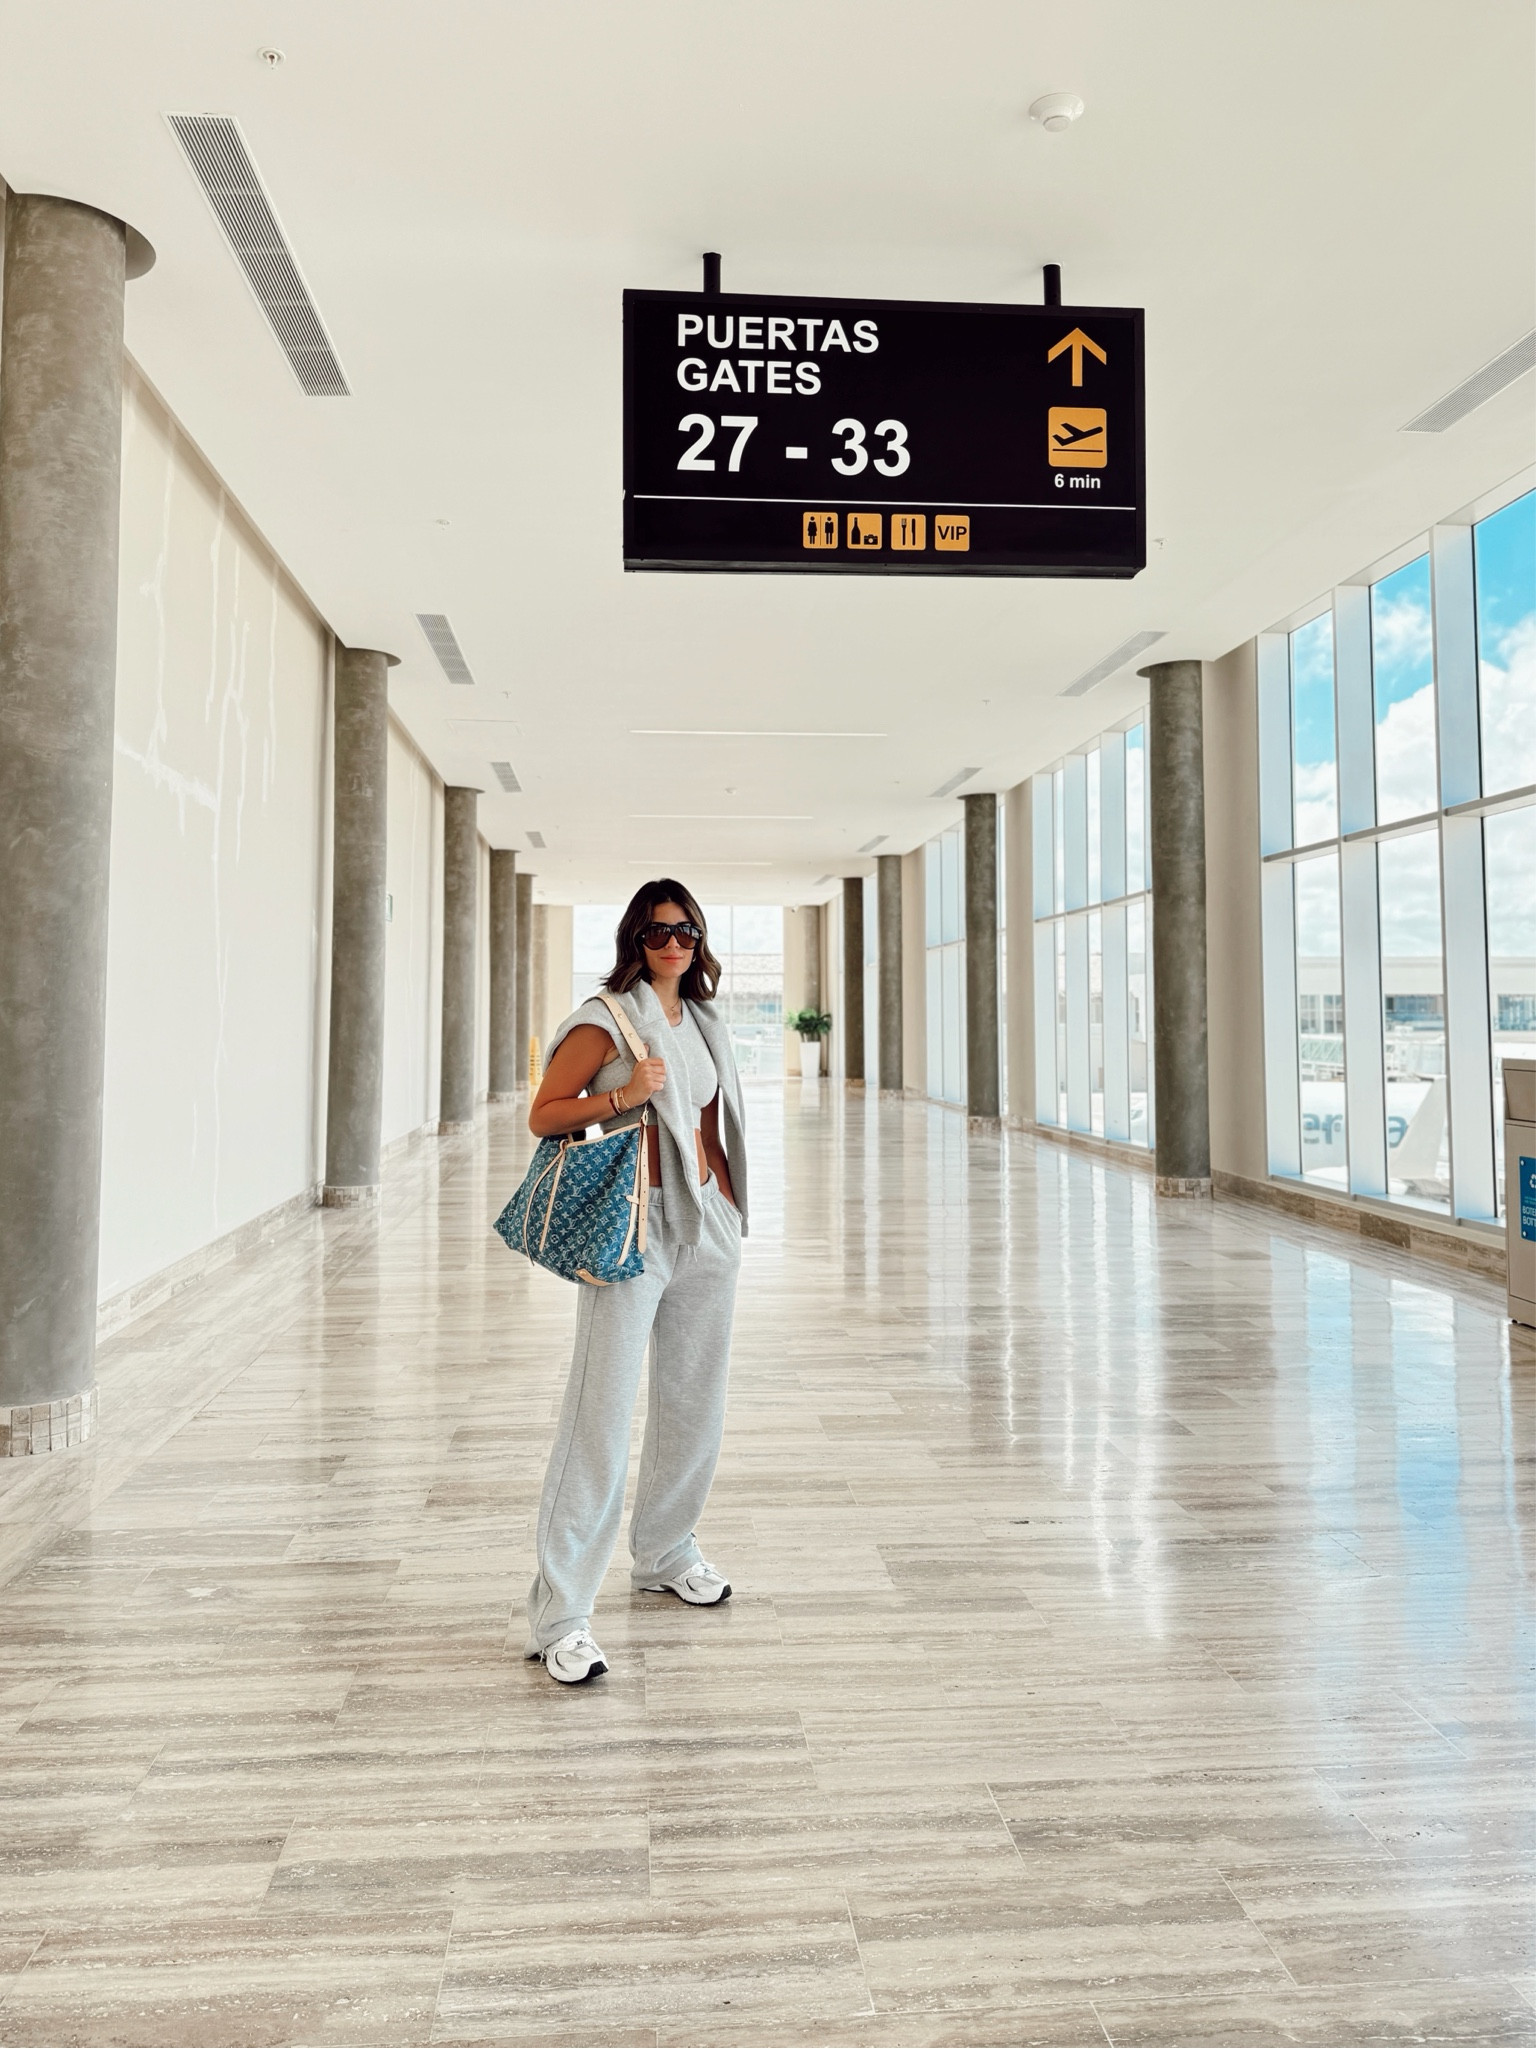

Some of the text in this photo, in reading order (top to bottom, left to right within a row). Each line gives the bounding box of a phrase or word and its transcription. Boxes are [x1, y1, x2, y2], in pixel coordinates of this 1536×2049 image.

[677, 313, 880, 354] PUERTAS
[676, 357, 822, 396] GATES
[676, 413, 911, 477] 27 - 33
[1054, 473, 1101, 489] 6 min
[937, 525, 968, 541] VIP
